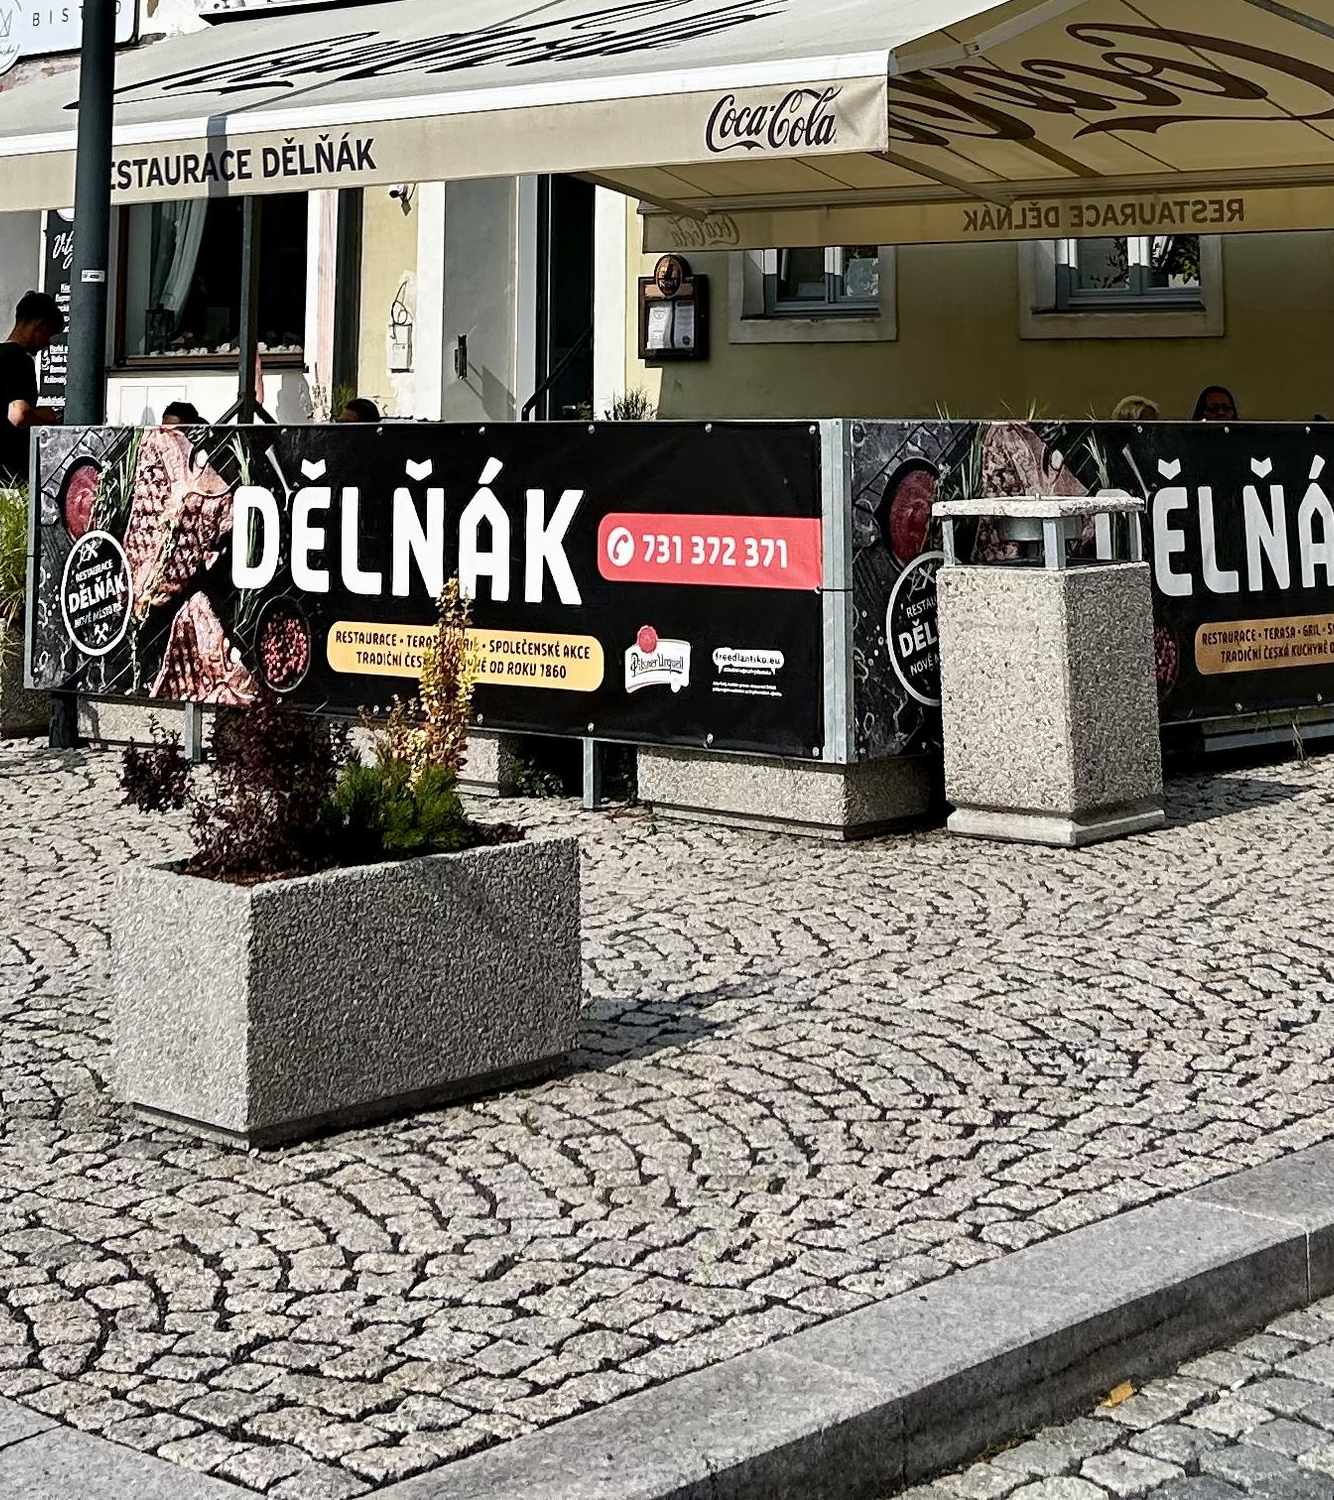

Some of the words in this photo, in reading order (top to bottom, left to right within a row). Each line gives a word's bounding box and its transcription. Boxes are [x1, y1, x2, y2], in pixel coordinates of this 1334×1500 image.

[705, 85, 843, 153] Coca-Cola
[110, 149, 253, 191] ESTAURACE
[261, 132, 377, 178] DĚLŇÁK
[231, 456, 585, 606] DĚLŇÁK
[641, 534, 682, 565] 731
[690, 536, 737, 566] 372
[744, 537, 788, 569] 371
[75, 559, 114, 582] RESTAURACE
[68, 571, 126, 614] DĚLŇÁK
[336, 630, 397, 648] RESTAURACE
[407, 634, 440, 651] TERAS
[489, 638, 561, 658] SPOLEČENSKÉ
[564, 644, 591, 660] AKCE
[898, 618, 938, 658] DĚL
[1202, 628, 1257, 646] RESTAURACE
[1263, 626, 1296, 643] TERASA
[1302, 624, 1321, 638] GRIL
[356, 650, 402, 668] TRADIČNÍ
[489, 660, 504, 675] OD
[507, 660, 537, 677] ROKU
[540, 663, 567, 680] 1860
[1221, 647, 1262, 665] TRADIČNÍ
[1263, 643, 1290, 661] ČESKÁ
